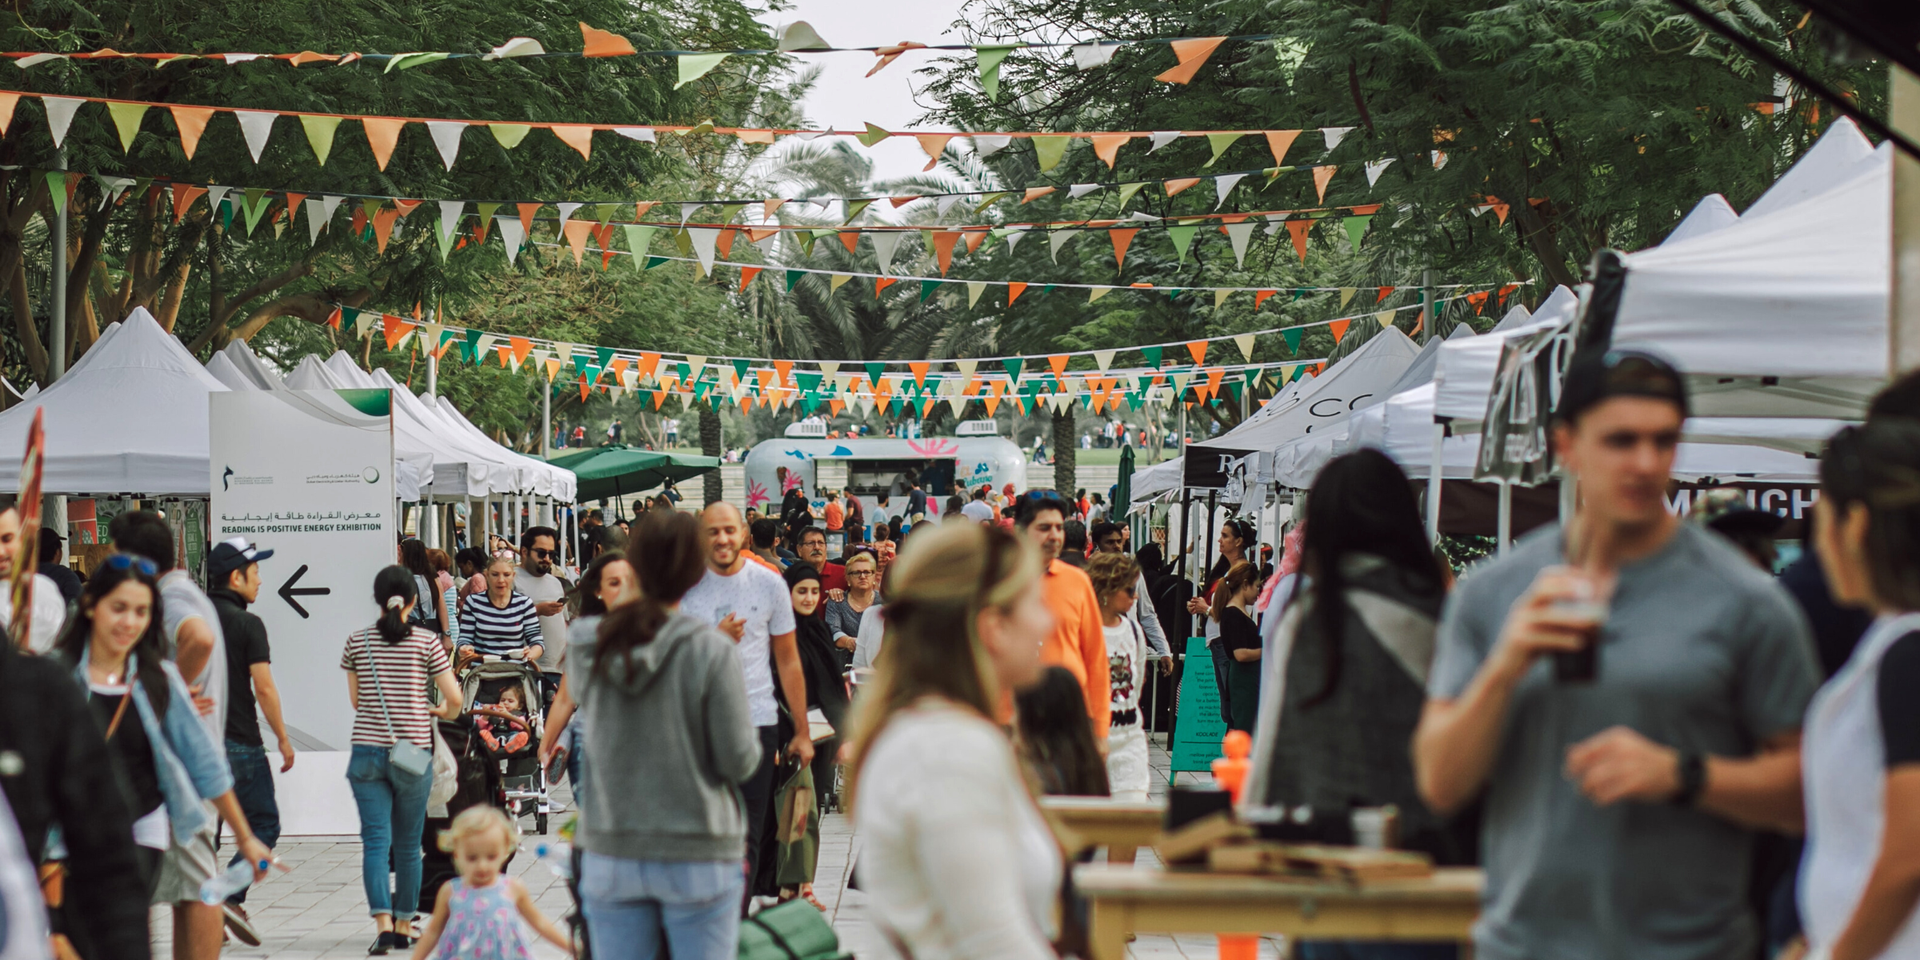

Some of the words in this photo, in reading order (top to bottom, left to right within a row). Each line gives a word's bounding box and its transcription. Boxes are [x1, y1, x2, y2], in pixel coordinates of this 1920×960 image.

[221, 512, 273, 523] إيجابية
[274, 510, 305, 520] طاقة
[306, 510, 342, 521] القراءة
[343, 511, 381, 521] معرض
[221, 525, 256, 534] READING
[257, 525, 265, 533] IS
[266, 524, 302, 533] POSITIVE
[304, 524, 335, 532] ENERGY
[336, 523, 382, 531] EXHIBITION
